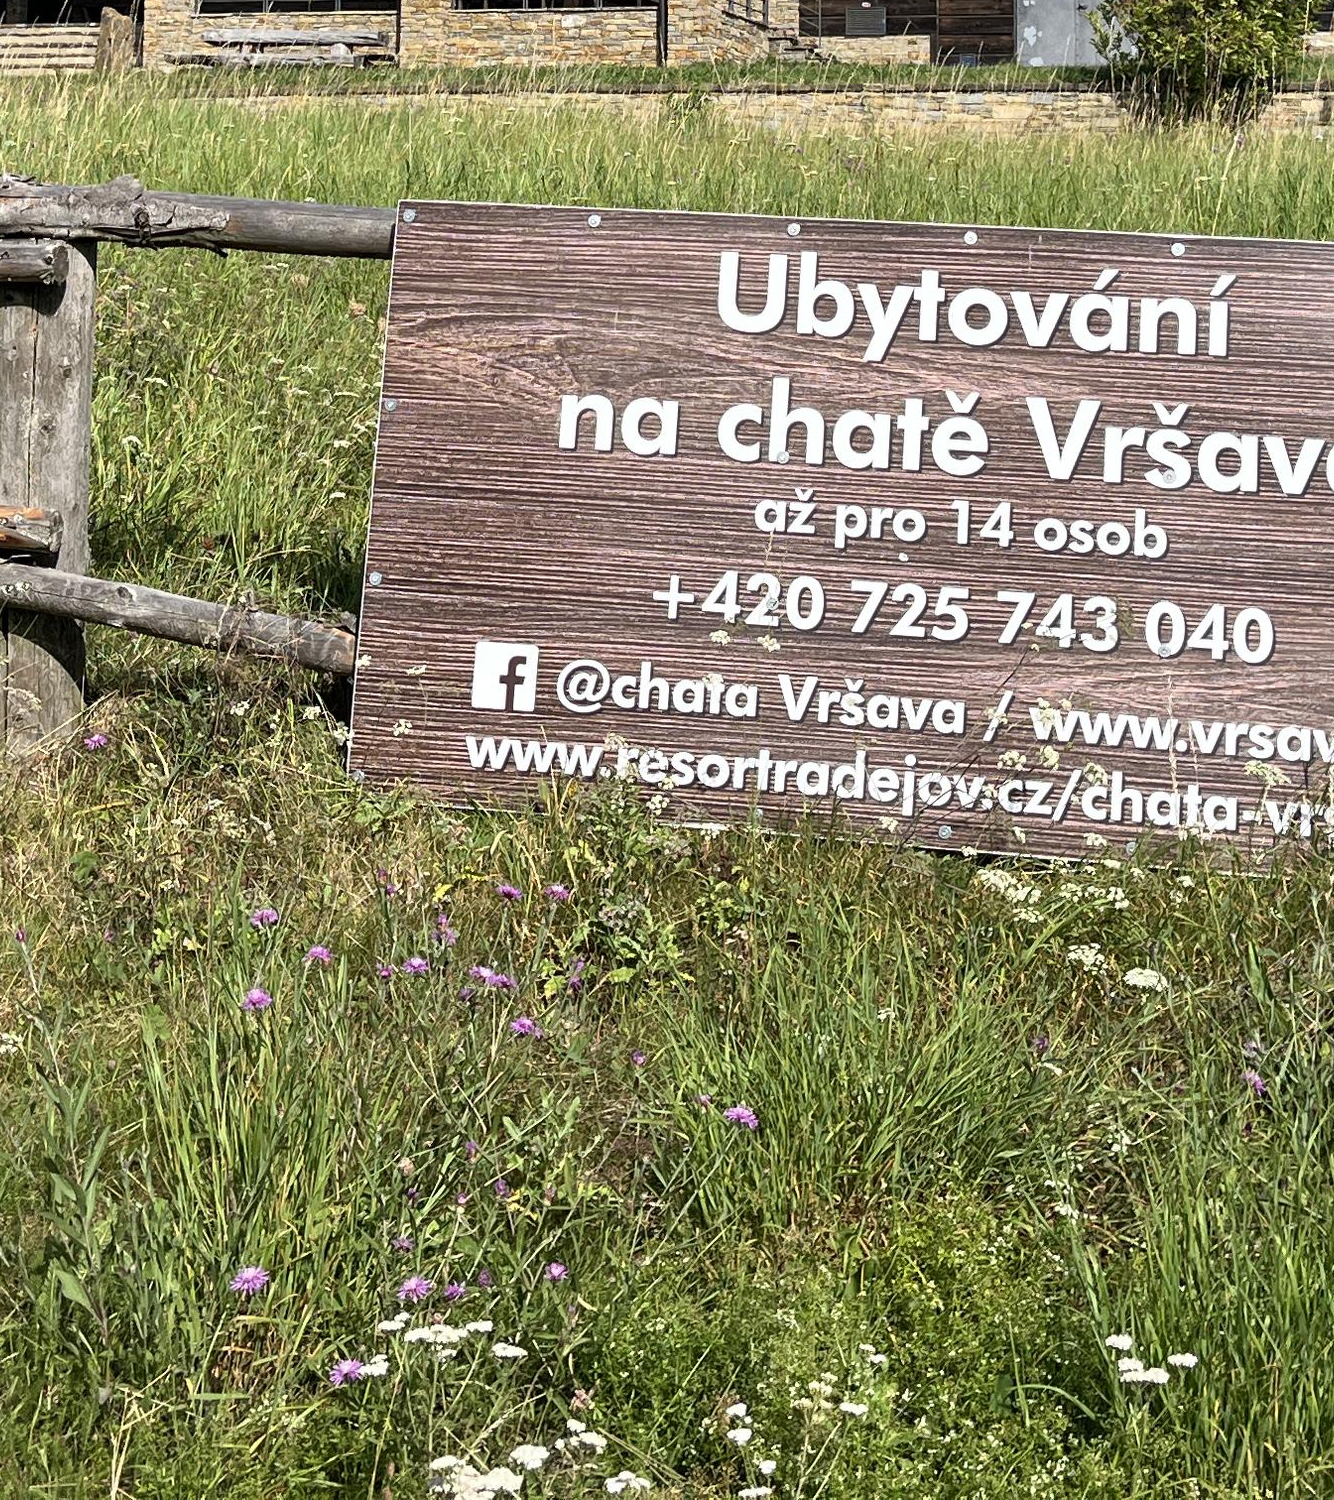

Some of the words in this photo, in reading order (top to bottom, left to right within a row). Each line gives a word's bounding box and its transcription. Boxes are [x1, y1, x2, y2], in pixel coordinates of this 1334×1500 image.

[718, 250, 1238, 362] Ubytování
[558, 393, 680, 456] na
[717, 377, 989, 476] chatě
[754, 487, 817, 534] až
[833, 503, 927, 549] pro
[949, 500, 1014, 548] 14
[1033, 508, 1168, 559] osob
[652, 570, 826, 631] +420
[850, 580, 969, 641] 725
[995, 591, 1120, 652] 743
[1144, 600, 1275, 665] 040
[555, 658, 759, 718] @chata
[778, 674, 966, 735] Vršava
